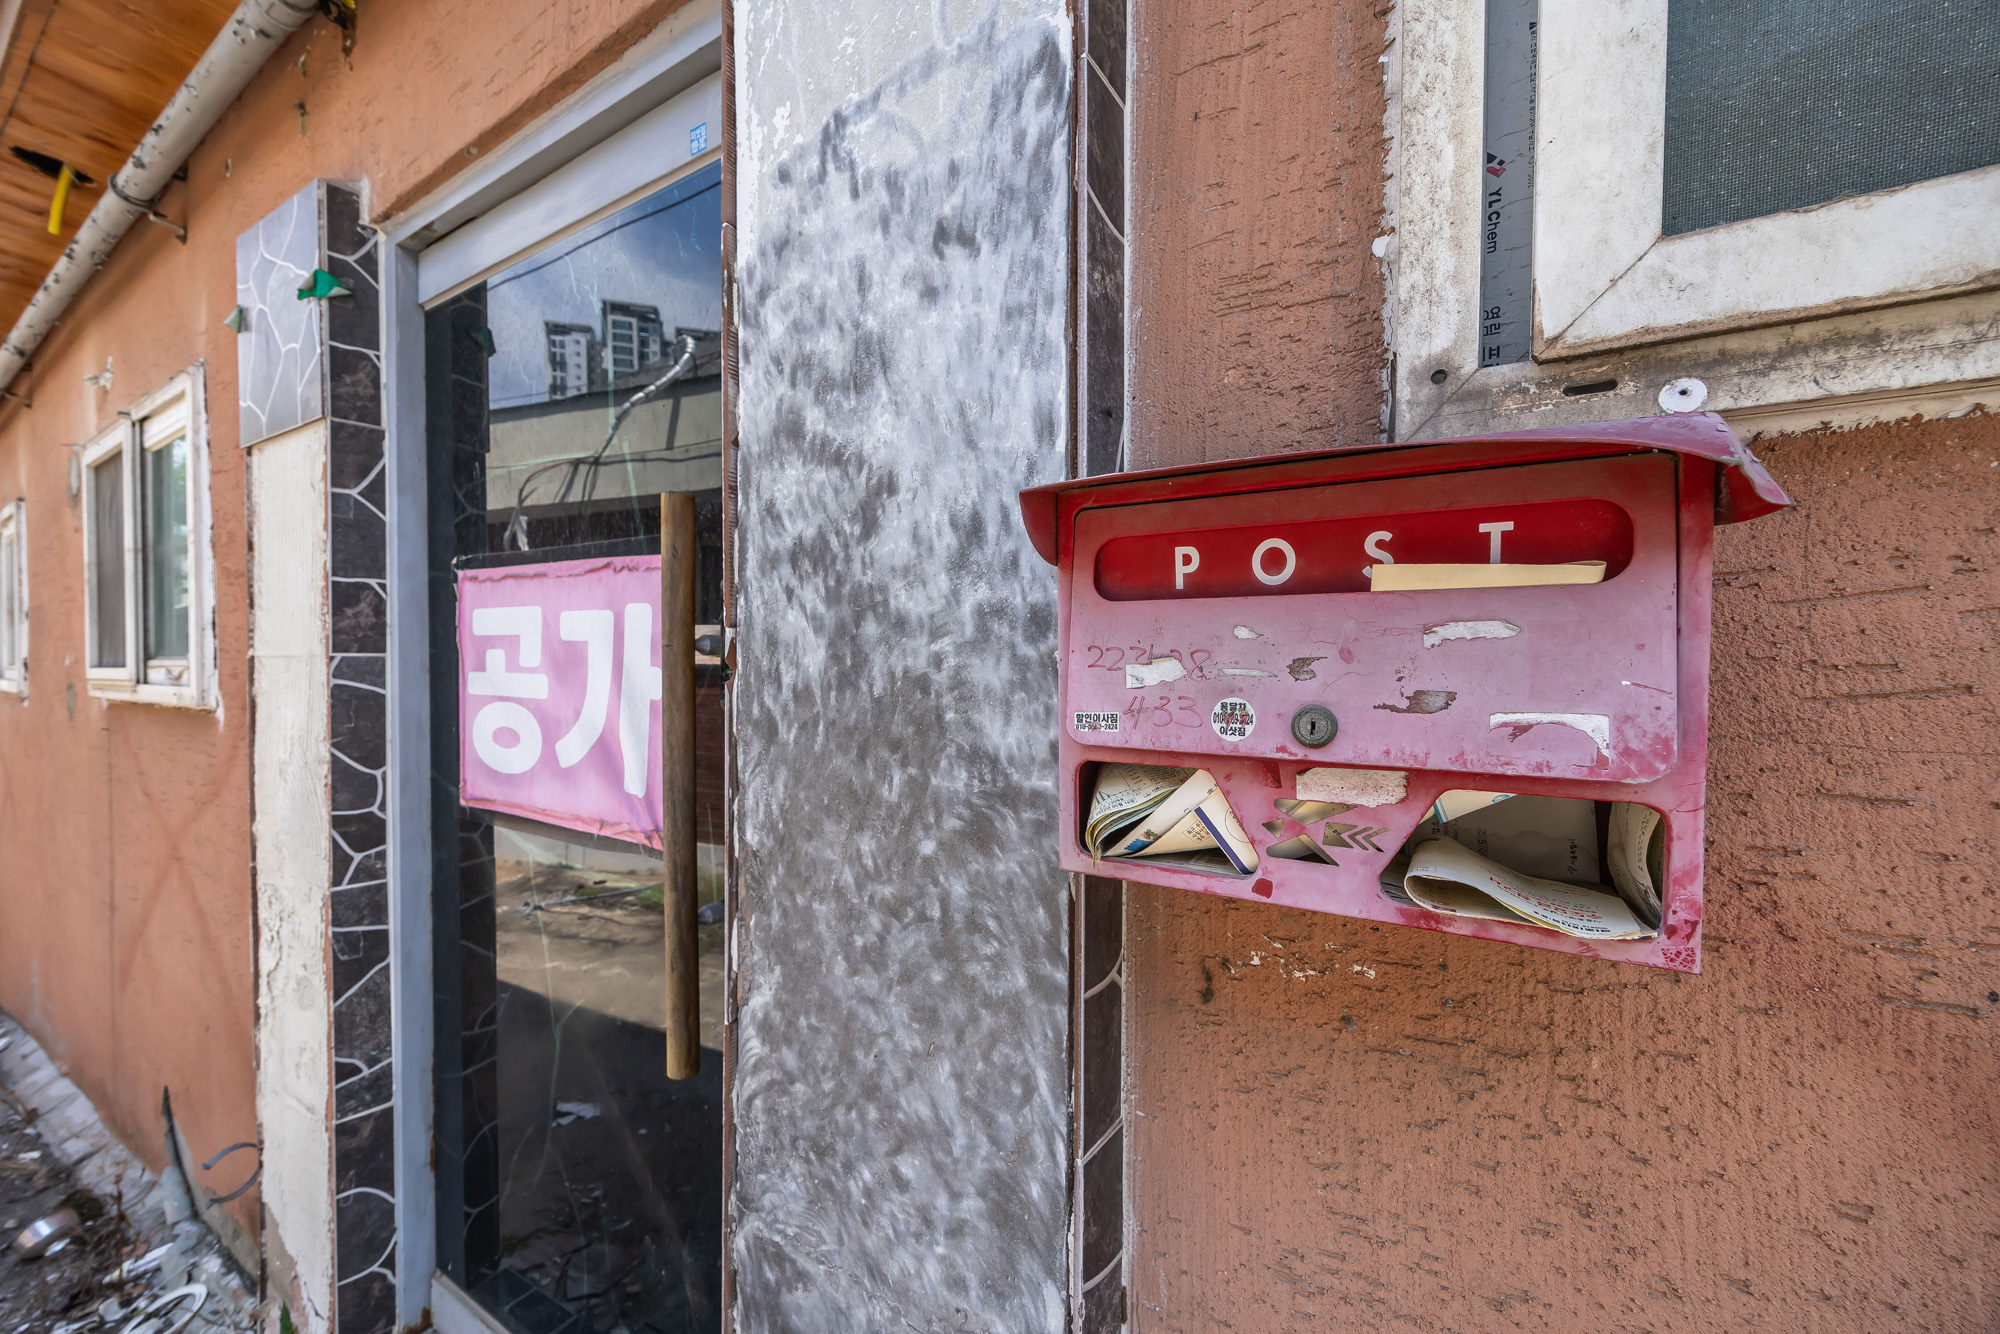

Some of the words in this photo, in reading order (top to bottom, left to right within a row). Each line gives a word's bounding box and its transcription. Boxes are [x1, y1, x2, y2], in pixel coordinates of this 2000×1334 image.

[1174, 521, 1514, 589] POST
[467, 602, 663, 798] 공가
[1219, 726, 1246, 737] 이삿짐
